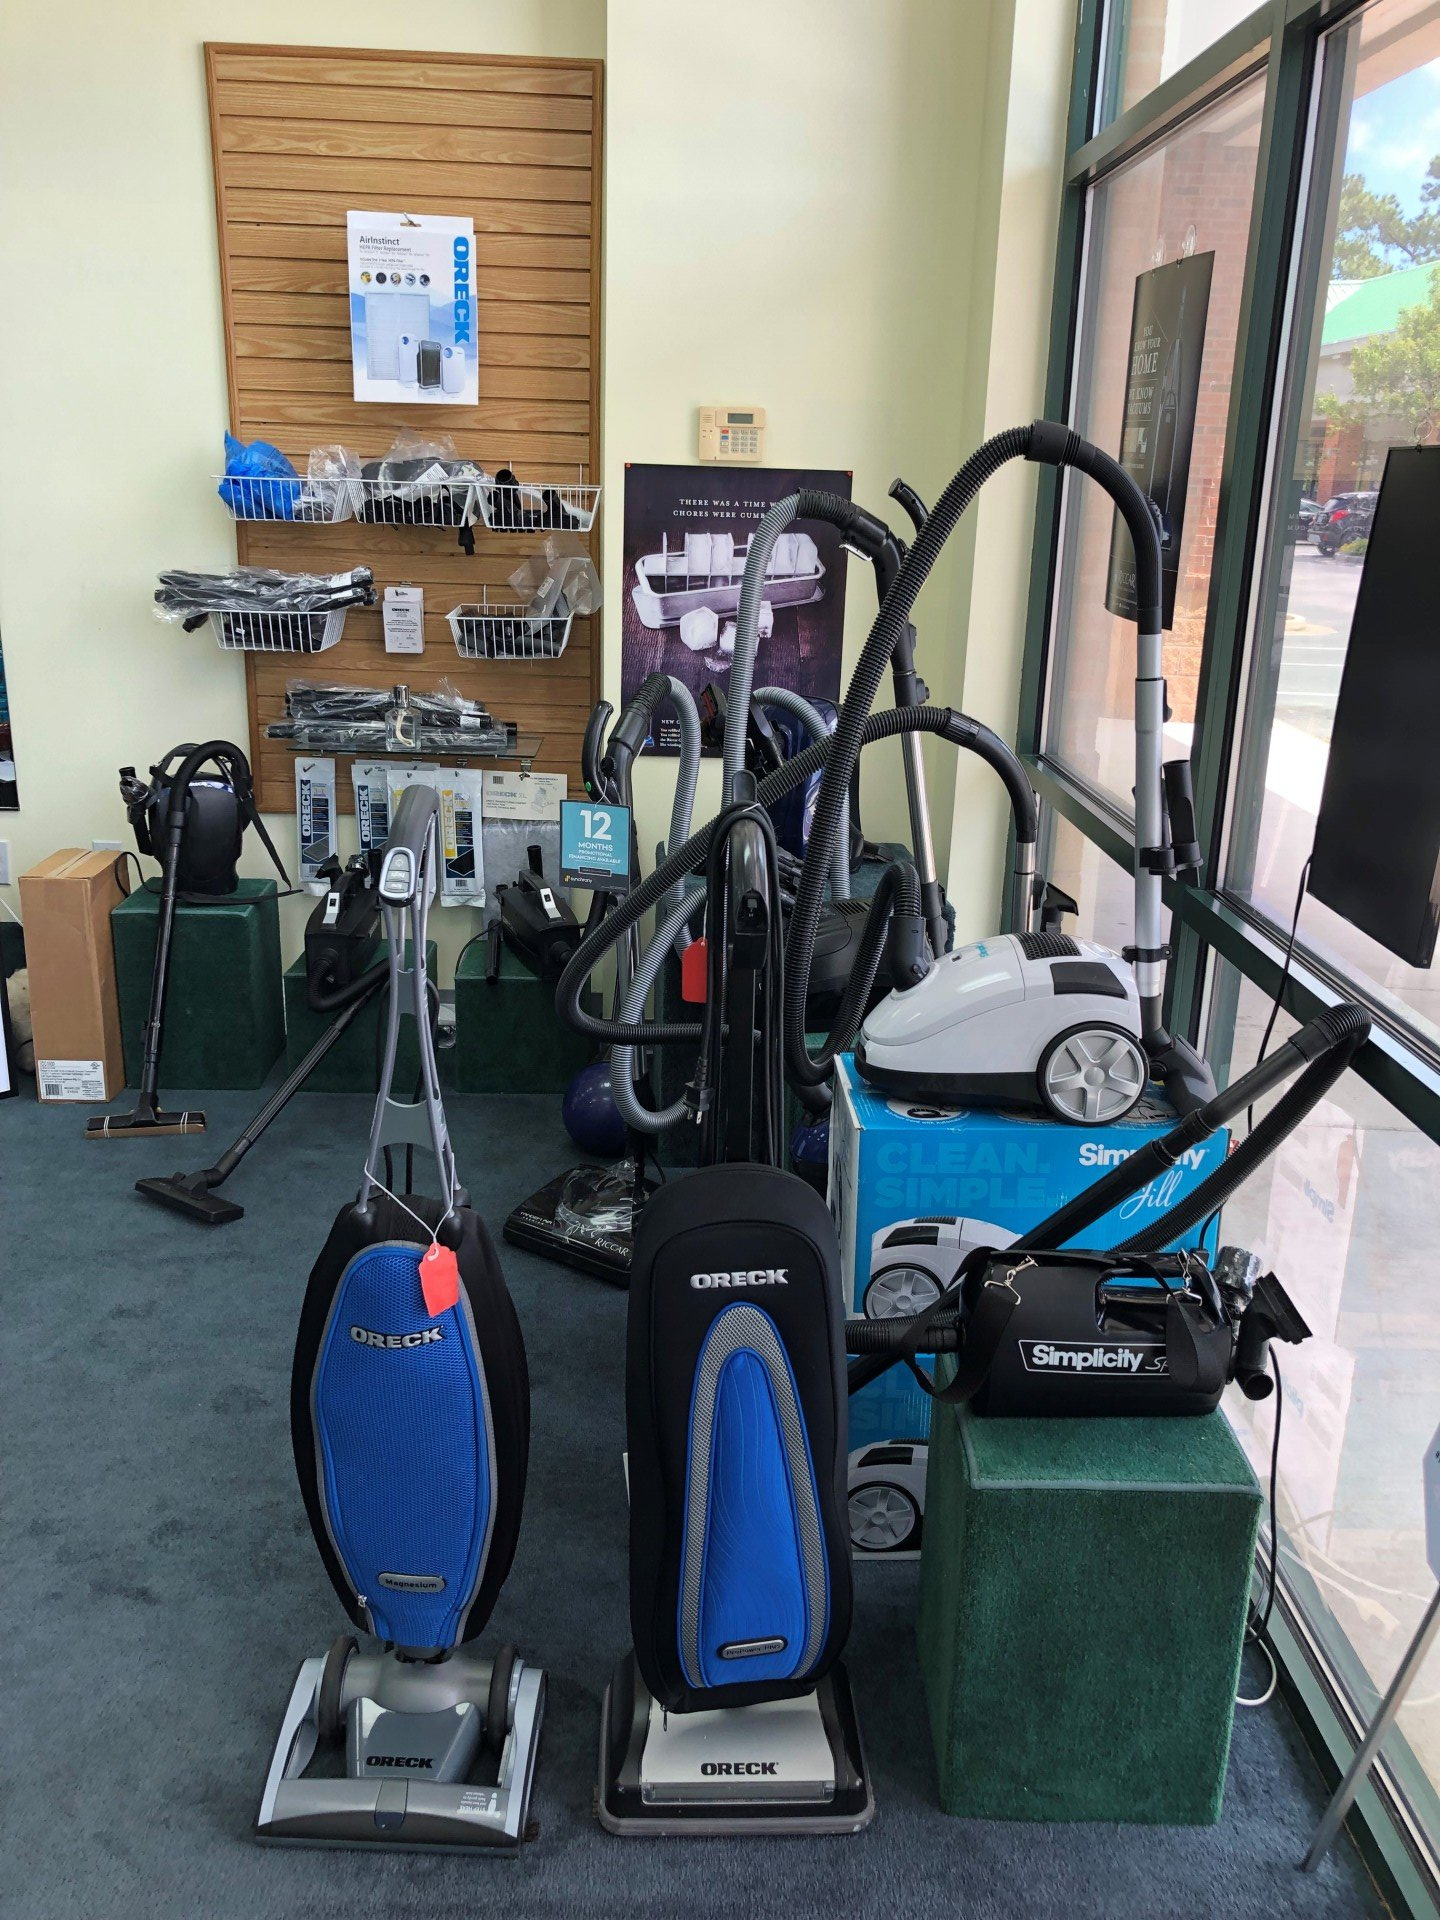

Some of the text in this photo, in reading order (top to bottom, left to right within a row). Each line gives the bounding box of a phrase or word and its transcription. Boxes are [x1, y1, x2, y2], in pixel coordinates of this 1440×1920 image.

[359, 235, 400, 246] AirInstinct
[454, 236, 470, 345] ORECK
[1147, 337, 1161, 351] YOUR
[1131, 352, 1159, 376] HOME
[1136, 386, 1154, 400] KNOW
[679, 498, 709, 506] THERE
[673, 509, 709, 517] CHORES
[302, 782, 311, 837] ORECK
[359, 788, 371, 842] ORECK
[580, 809, 612, 841] 12
[578, 842, 614, 852] MONTHS
[578, 849, 613, 858] PROMOTIONAL
[876, 1142, 1050, 1174] CLEAN.
[1078, 1142, 1205, 1170] Simty
[875, 1176, 1056, 1208] SIMPLE.
[1119, 1170, 1184, 1220] Jill
[594, 1237, 630, 1256] RICCAR
[690, 1269, 789, 1289] ORECK
[350, 1326, 444, 1349] ORECK
[1032, 1344, 1144, 1372] Simplicity
[385, 1578, 437, 1589] Magnesium
[366, 1755, 435, 1769] ORECK
[701, 1762, 779, 1776] ORECK
